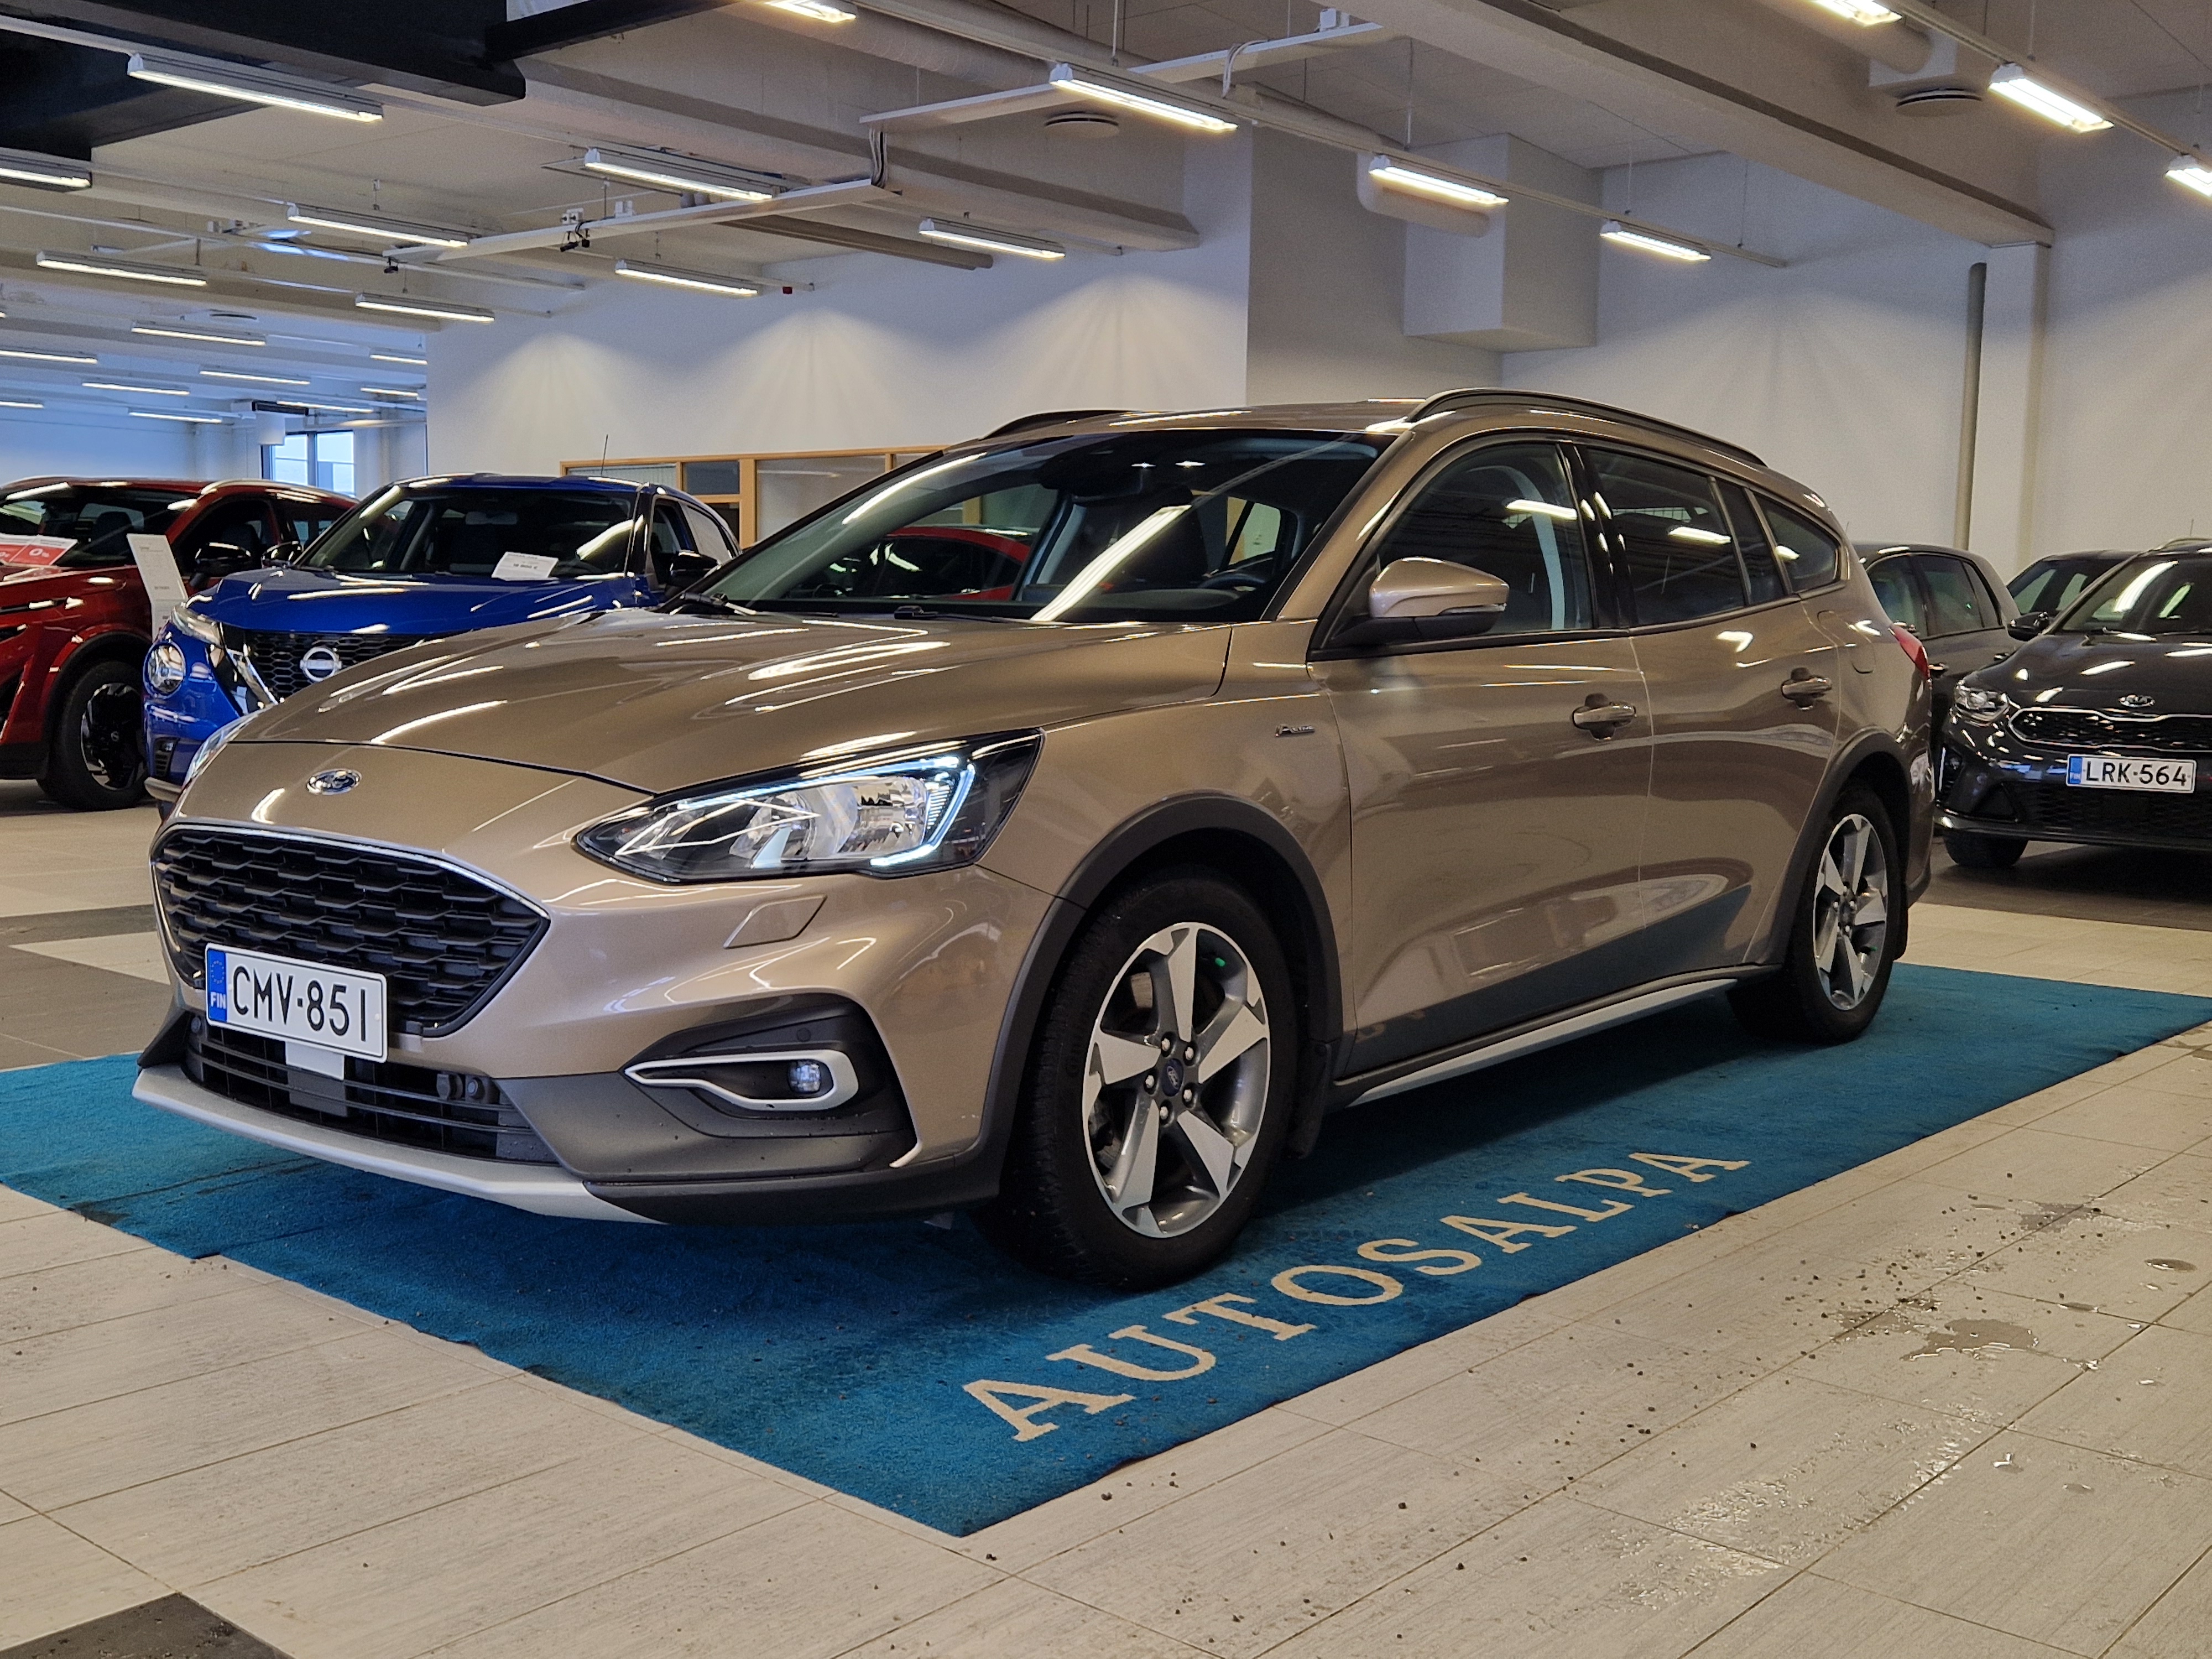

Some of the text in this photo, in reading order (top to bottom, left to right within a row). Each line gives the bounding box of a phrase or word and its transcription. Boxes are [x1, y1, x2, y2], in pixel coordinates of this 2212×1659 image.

[2086, 761, 2187, 786] LRK-564
[210, 992, 226, 1010] FIN
[233, 966, 366, 1042] CMV-851
[963, 1152, 1750, 1442] AUTOSALPA
